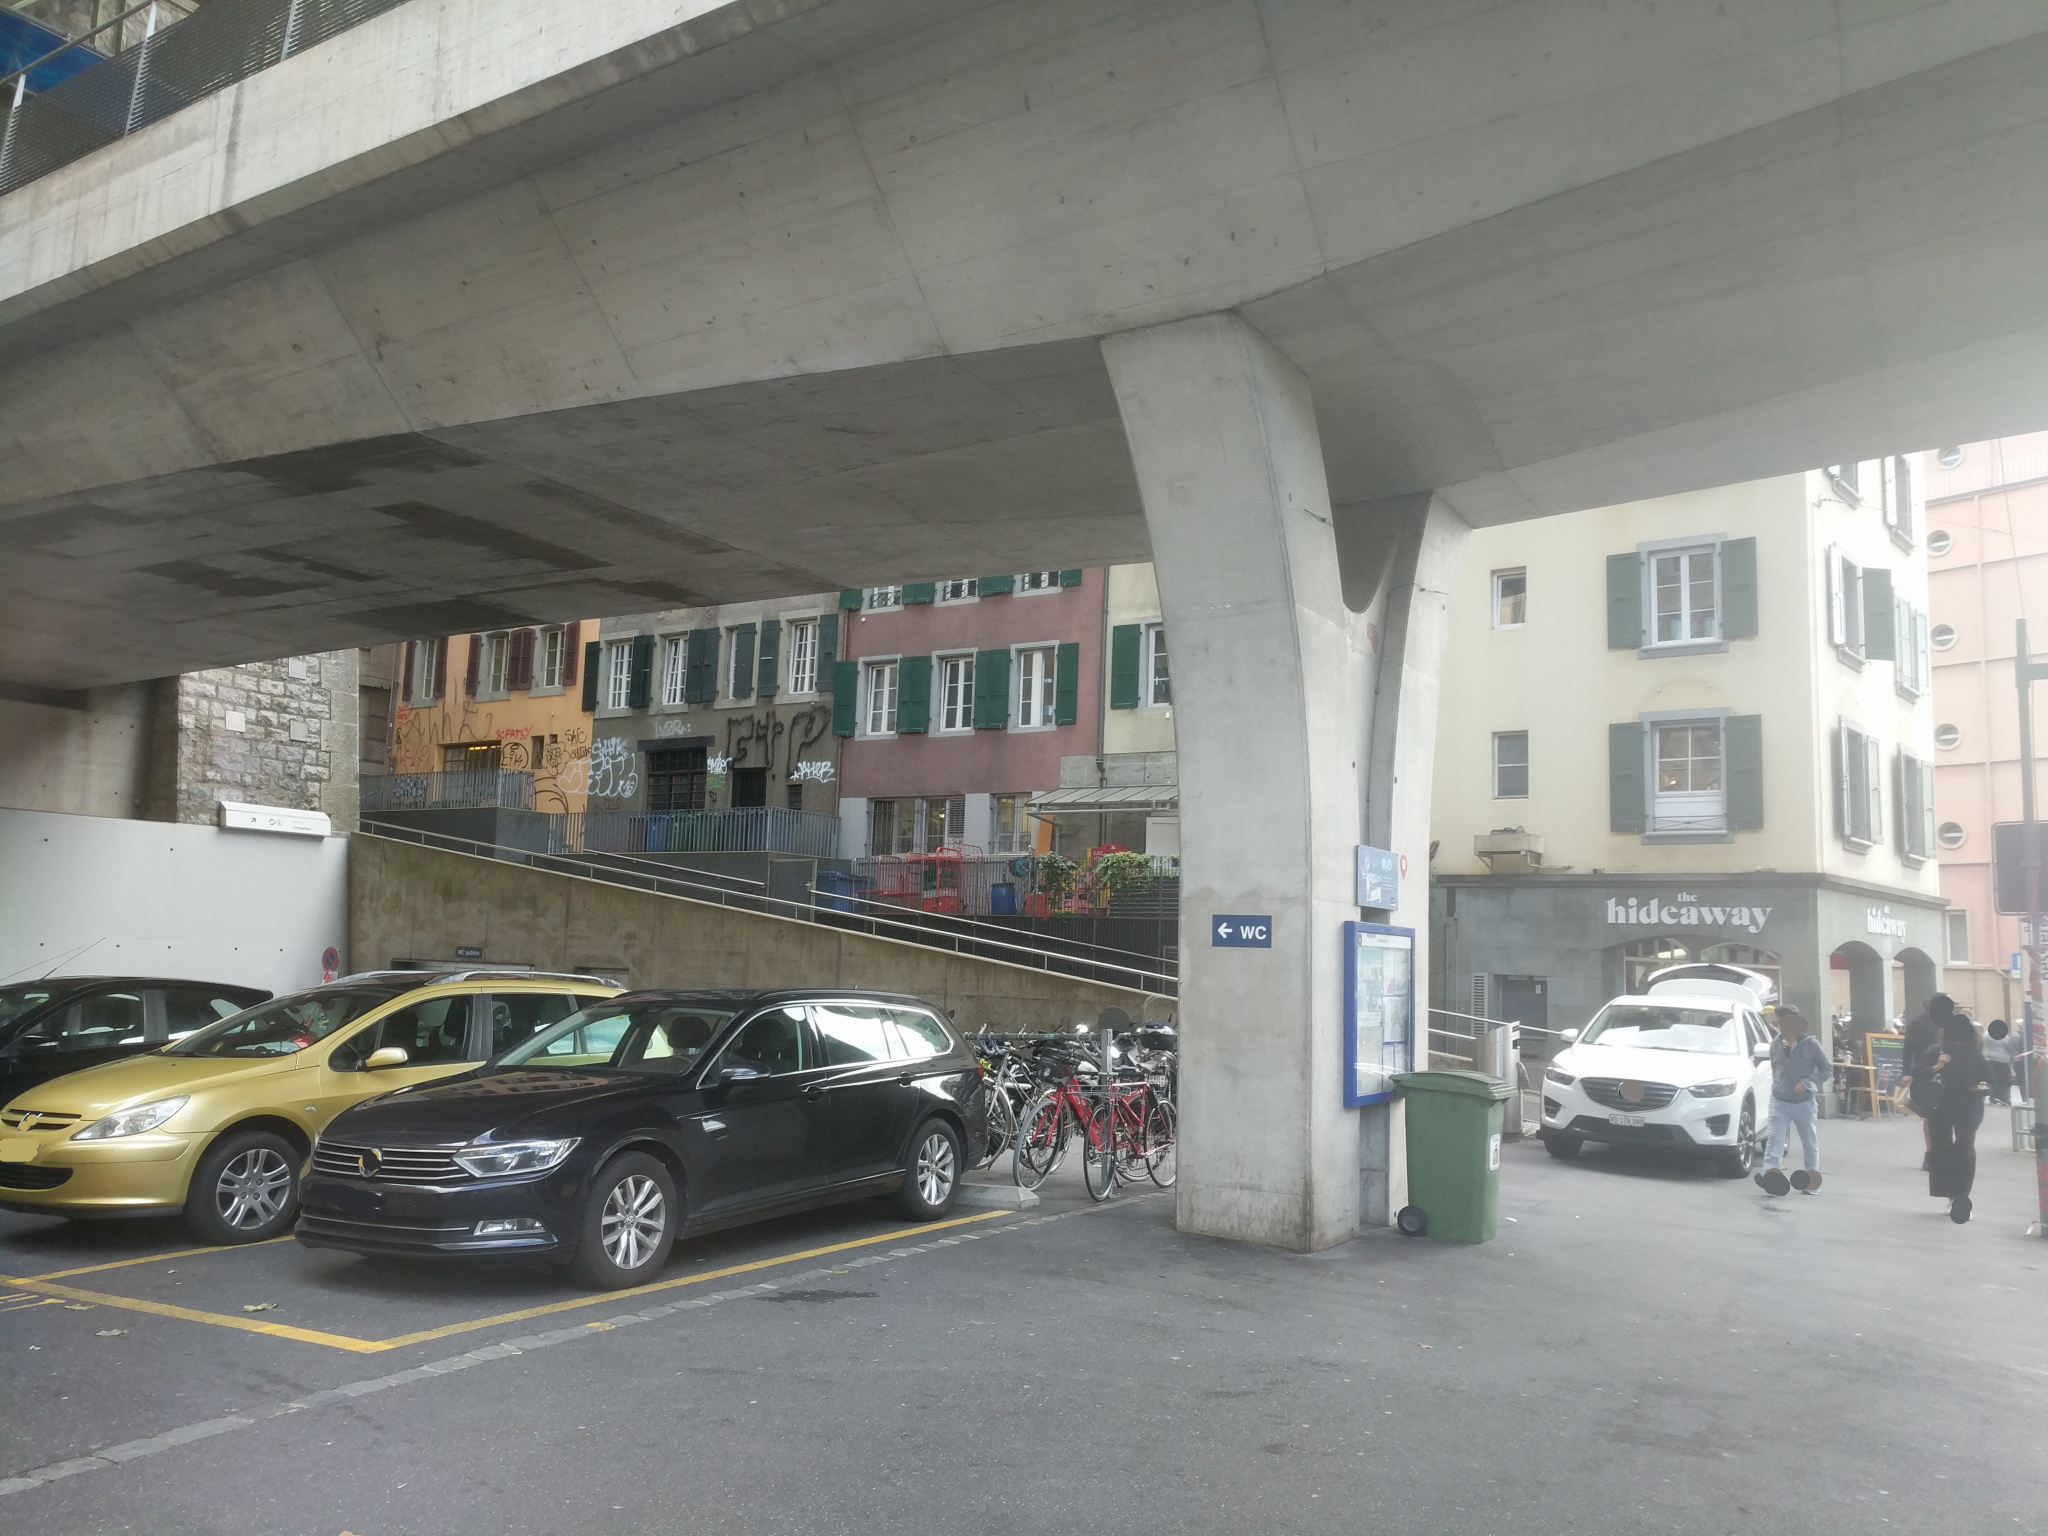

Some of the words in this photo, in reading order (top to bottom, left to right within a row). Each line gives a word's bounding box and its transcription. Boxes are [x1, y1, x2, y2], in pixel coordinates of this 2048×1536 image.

[1677, 891, 1699, 902] the
[1606, 897, 1774, 934] hideaway
[1867, 907, 1906, 944] hideaway
[1240, 925, 1267, 940] WC
